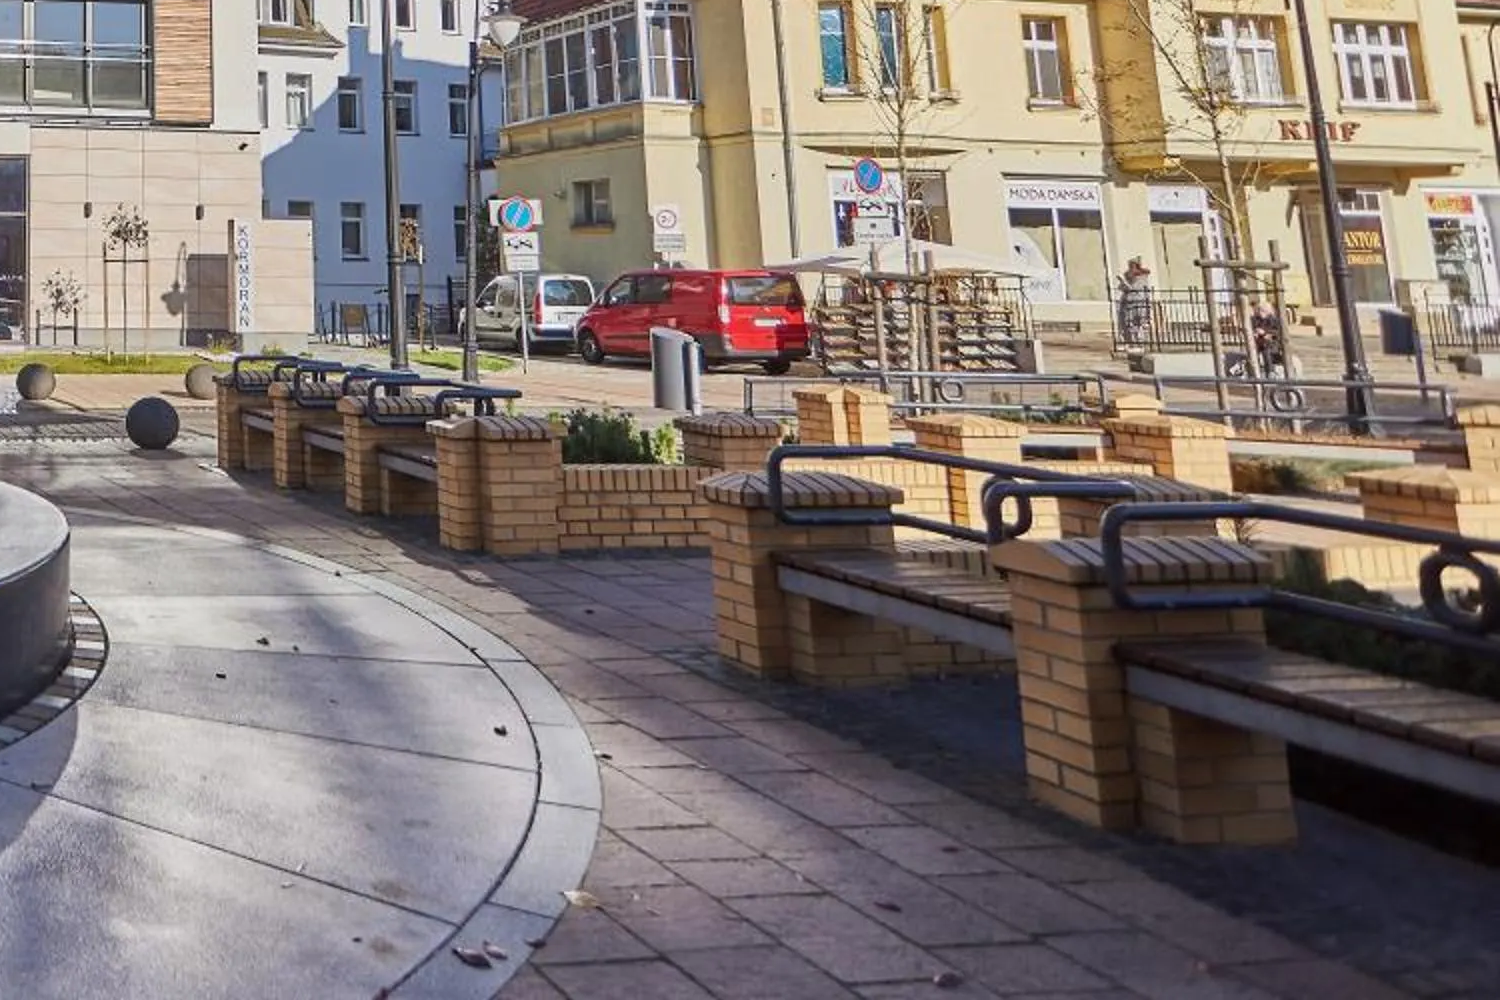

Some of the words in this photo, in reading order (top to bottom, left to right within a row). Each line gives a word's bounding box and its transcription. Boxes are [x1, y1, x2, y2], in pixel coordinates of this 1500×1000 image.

[1009, 187, 1045, 200] MODA
[1047, 188, 1095, 201] DAMSKA
[1343, 231, 1381, 249] ANTOR
[237, 225, 250, 327] KORMORAN
